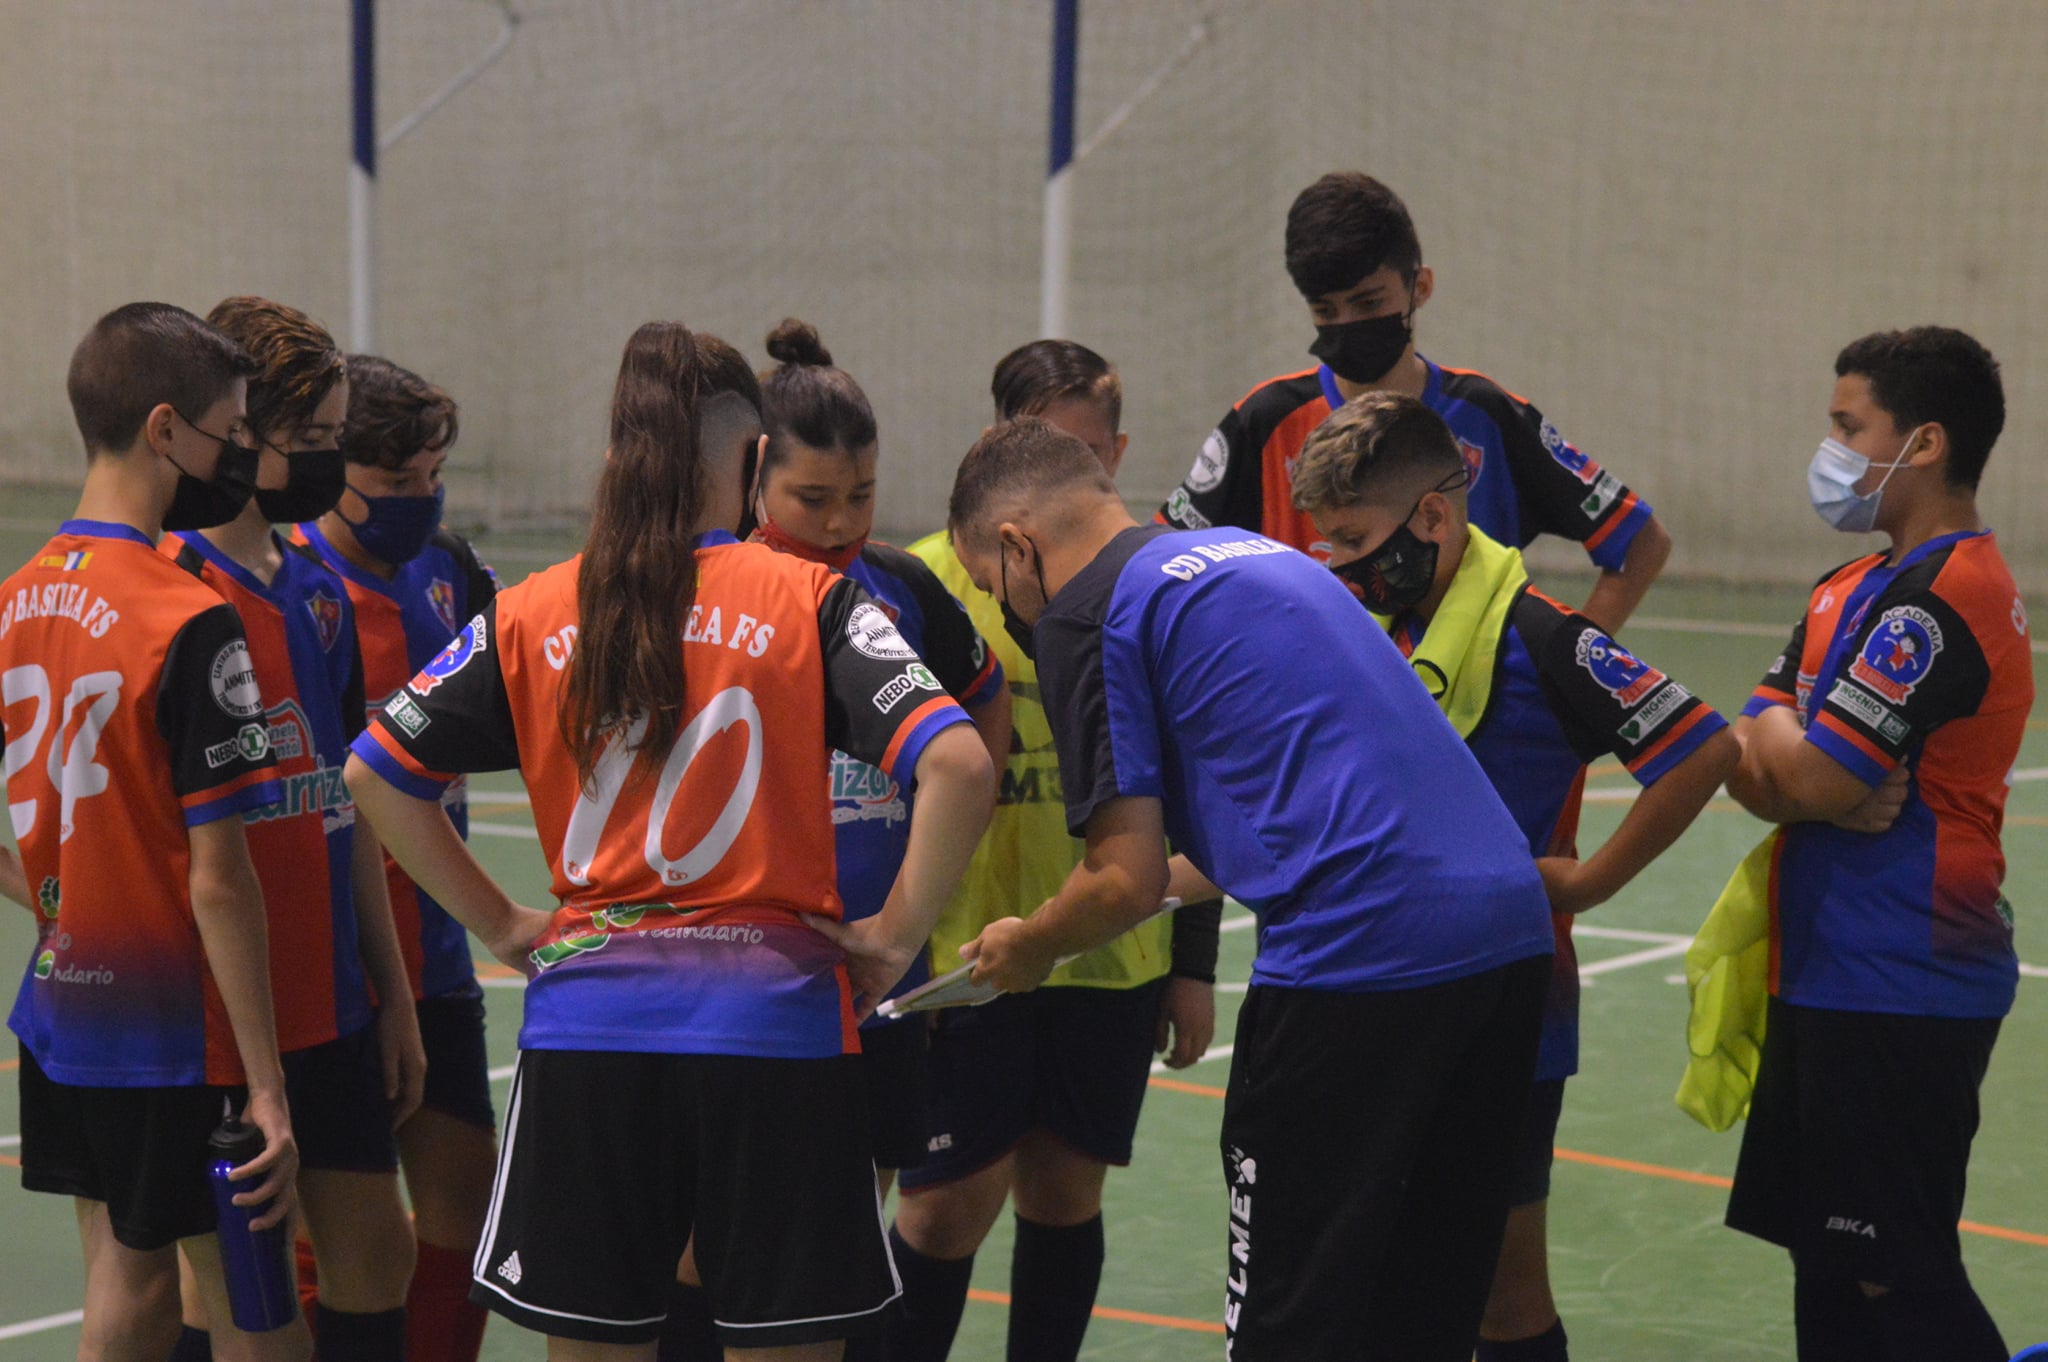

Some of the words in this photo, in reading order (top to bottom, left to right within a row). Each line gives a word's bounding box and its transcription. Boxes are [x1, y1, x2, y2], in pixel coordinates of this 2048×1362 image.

[1161, 554, 1207, 582] CD
[1191, 538, 1294, 563] BASILEA
[14, 583, 88, 622] BASILEA
[81, 596, 119, 638] FS
[1882, 608, 1941, 653] ACADEMIA
[543, 624, 579, 671] CD
[727, 613, 775, 658] FS
[875, 675, 913, 711] NEBO
[1639, 685, 1679, 721] INGENIO
[208, 739, 238, 763] NEBO
